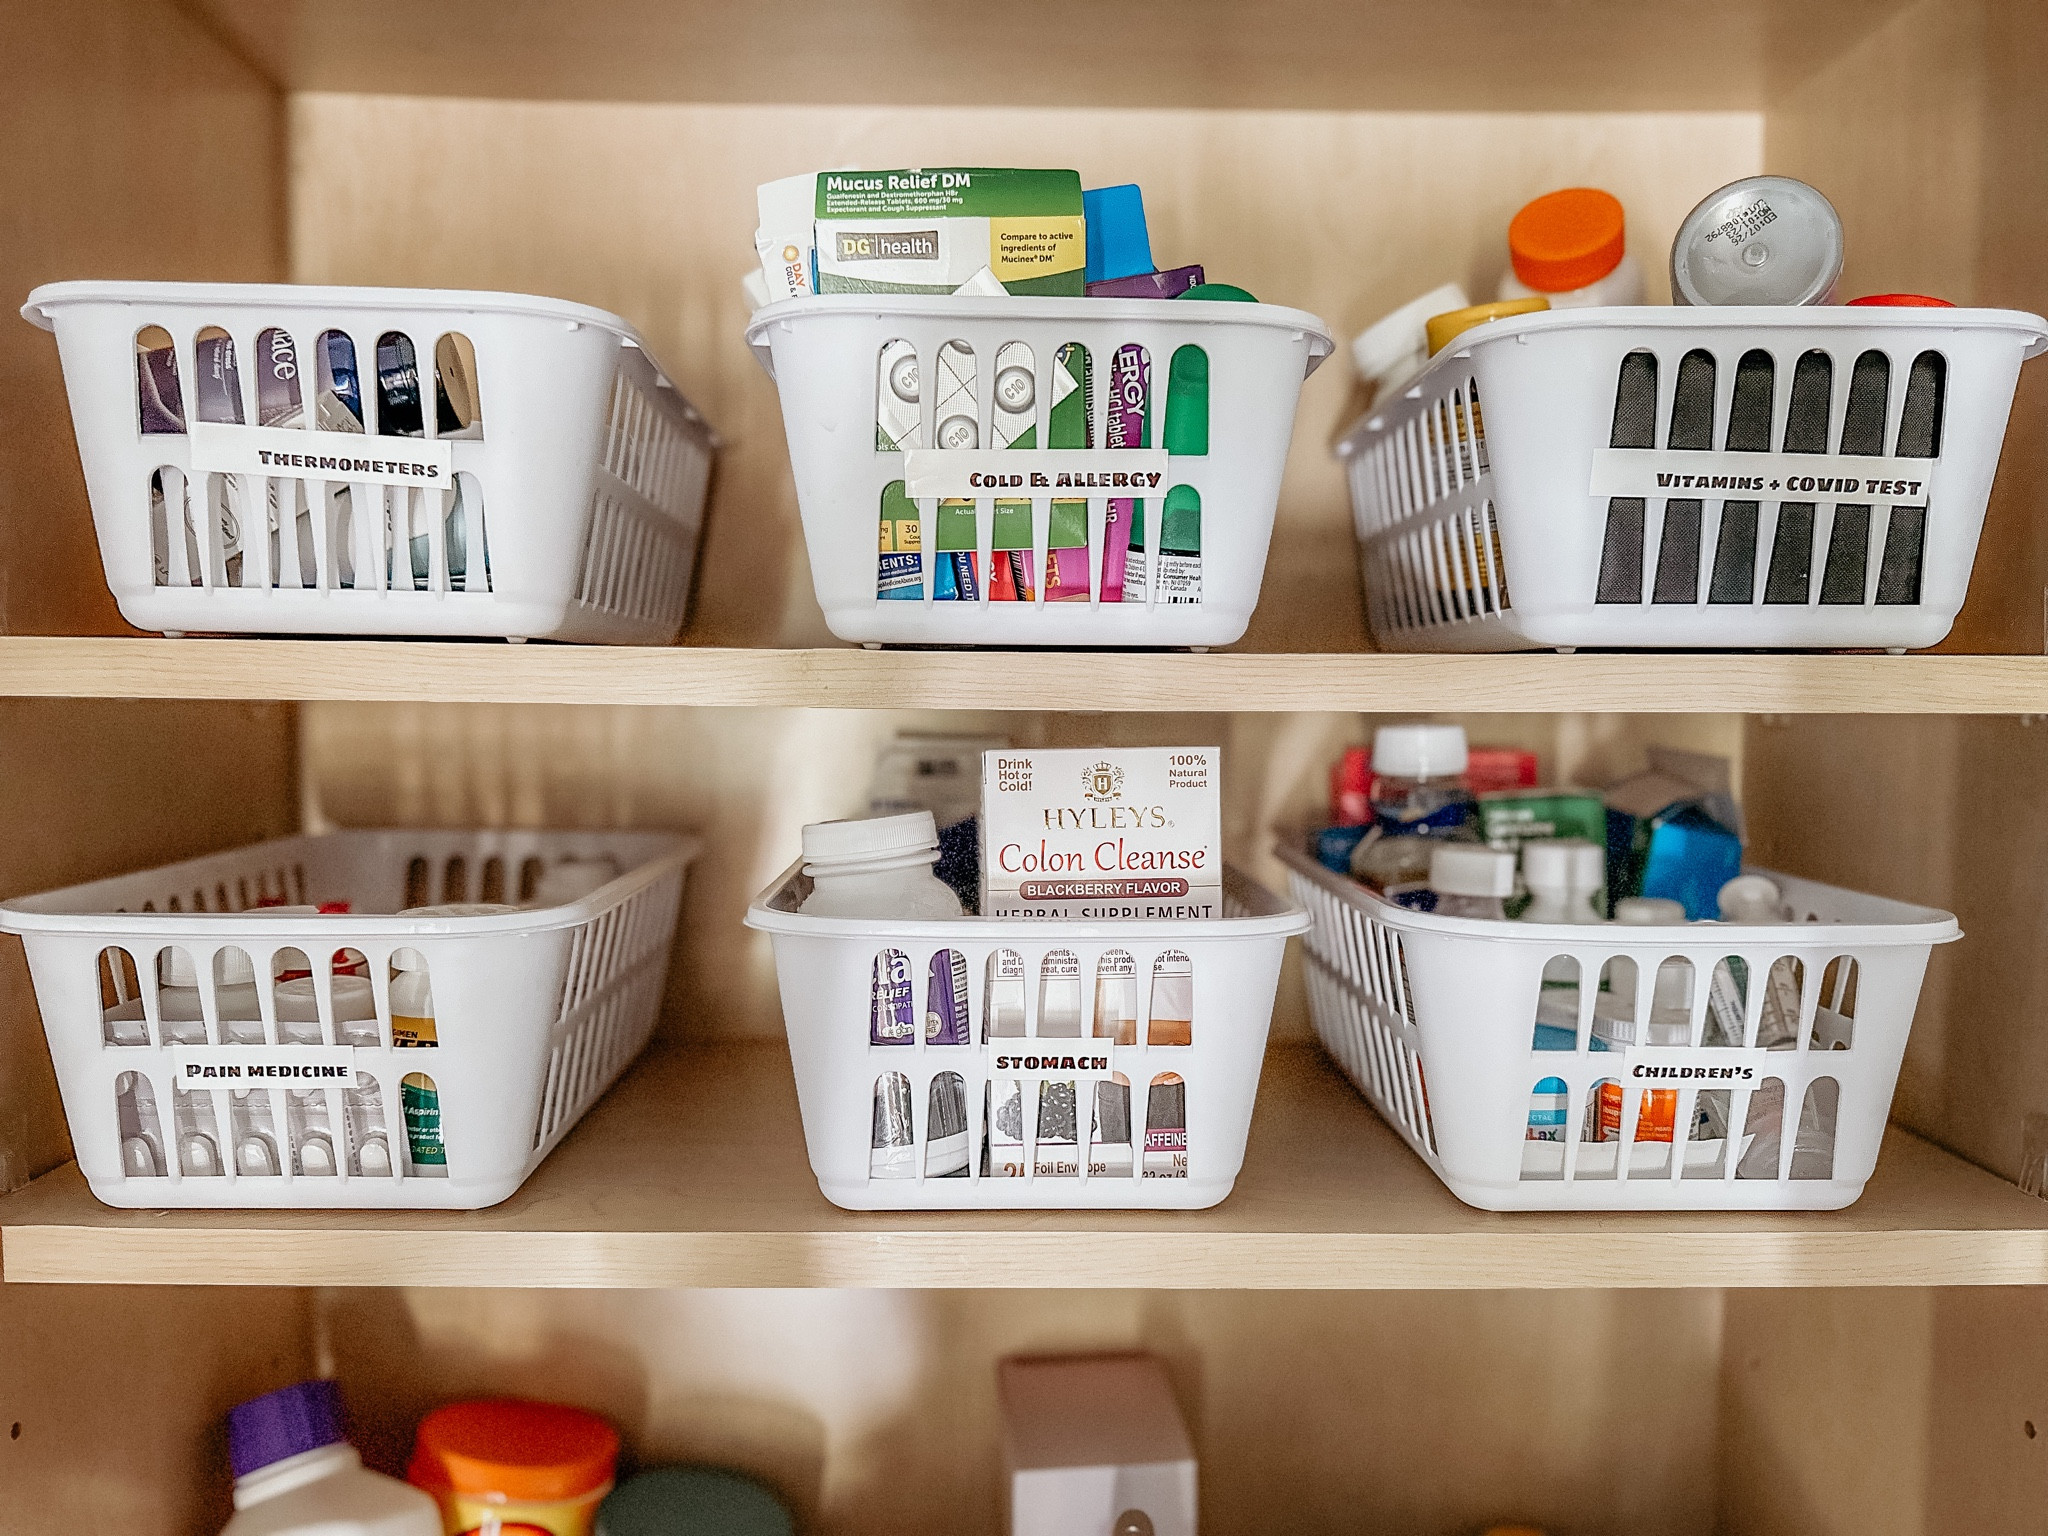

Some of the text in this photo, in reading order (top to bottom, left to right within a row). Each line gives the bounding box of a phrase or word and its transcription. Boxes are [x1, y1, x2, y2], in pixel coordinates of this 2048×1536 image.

[827, 173, 970, 191] Mucus Relief DM
[881, 191, 944, 199] Dextromethorphan
[882, 205, 904, 213] Cough
[906, 204, 947, 212] Suppressant
[1000, 233, 1037, 242] Compare
[1049, 232, 1074, 240] active
[842, 237, 933, 255] DG health
[1000, 243, 1056, 253] ingredients of
[785, 265, 796, 286] COLD
[792, 262, 806, 288] DAY
[1004, 378, 1026, 400] C10
[1119, 349, 1145, 417] ERGY
[948, 426, 970, 448] C10
[258, 450, 439, 478] THERMOMETERS
[970, 471, 1162, 488] COLD & ALLERGY
[1656, 473, 1922, 496] VITAMINS + COVID TEST
[905, 524, 918, 534] 30
[880, 555, 918, 571] ENTS:
[960, 564, 972, 591] NEED
[998, 758, 1033, 770] Drink
[1169, 755, 1207, 766] 100%
[998, 770, 1033, 780] Hot or
[1169, 769, 1207, 777] Natural
[999, 781, 1033, 792] Cold!
[1169, 780, 1208, 788] Product
[1000, 838, 1205, 873] Colon Cleanse
[1027, 881, 1181, 897] BLACKBERRY FLAVOR
[1002, 957, 1016, 965] and
[1061, 965, 1078, 973] cure
[1119, 964, 1132, 974] any
[996, 1056, 1108, 1070] STOMACH
[186, 1064, 348, 1078] PAIN MEDICINE
[1633, 1064, 1754, 1080] CHILDREN'S
[1034, 1162, 1054, 1174] Foil
